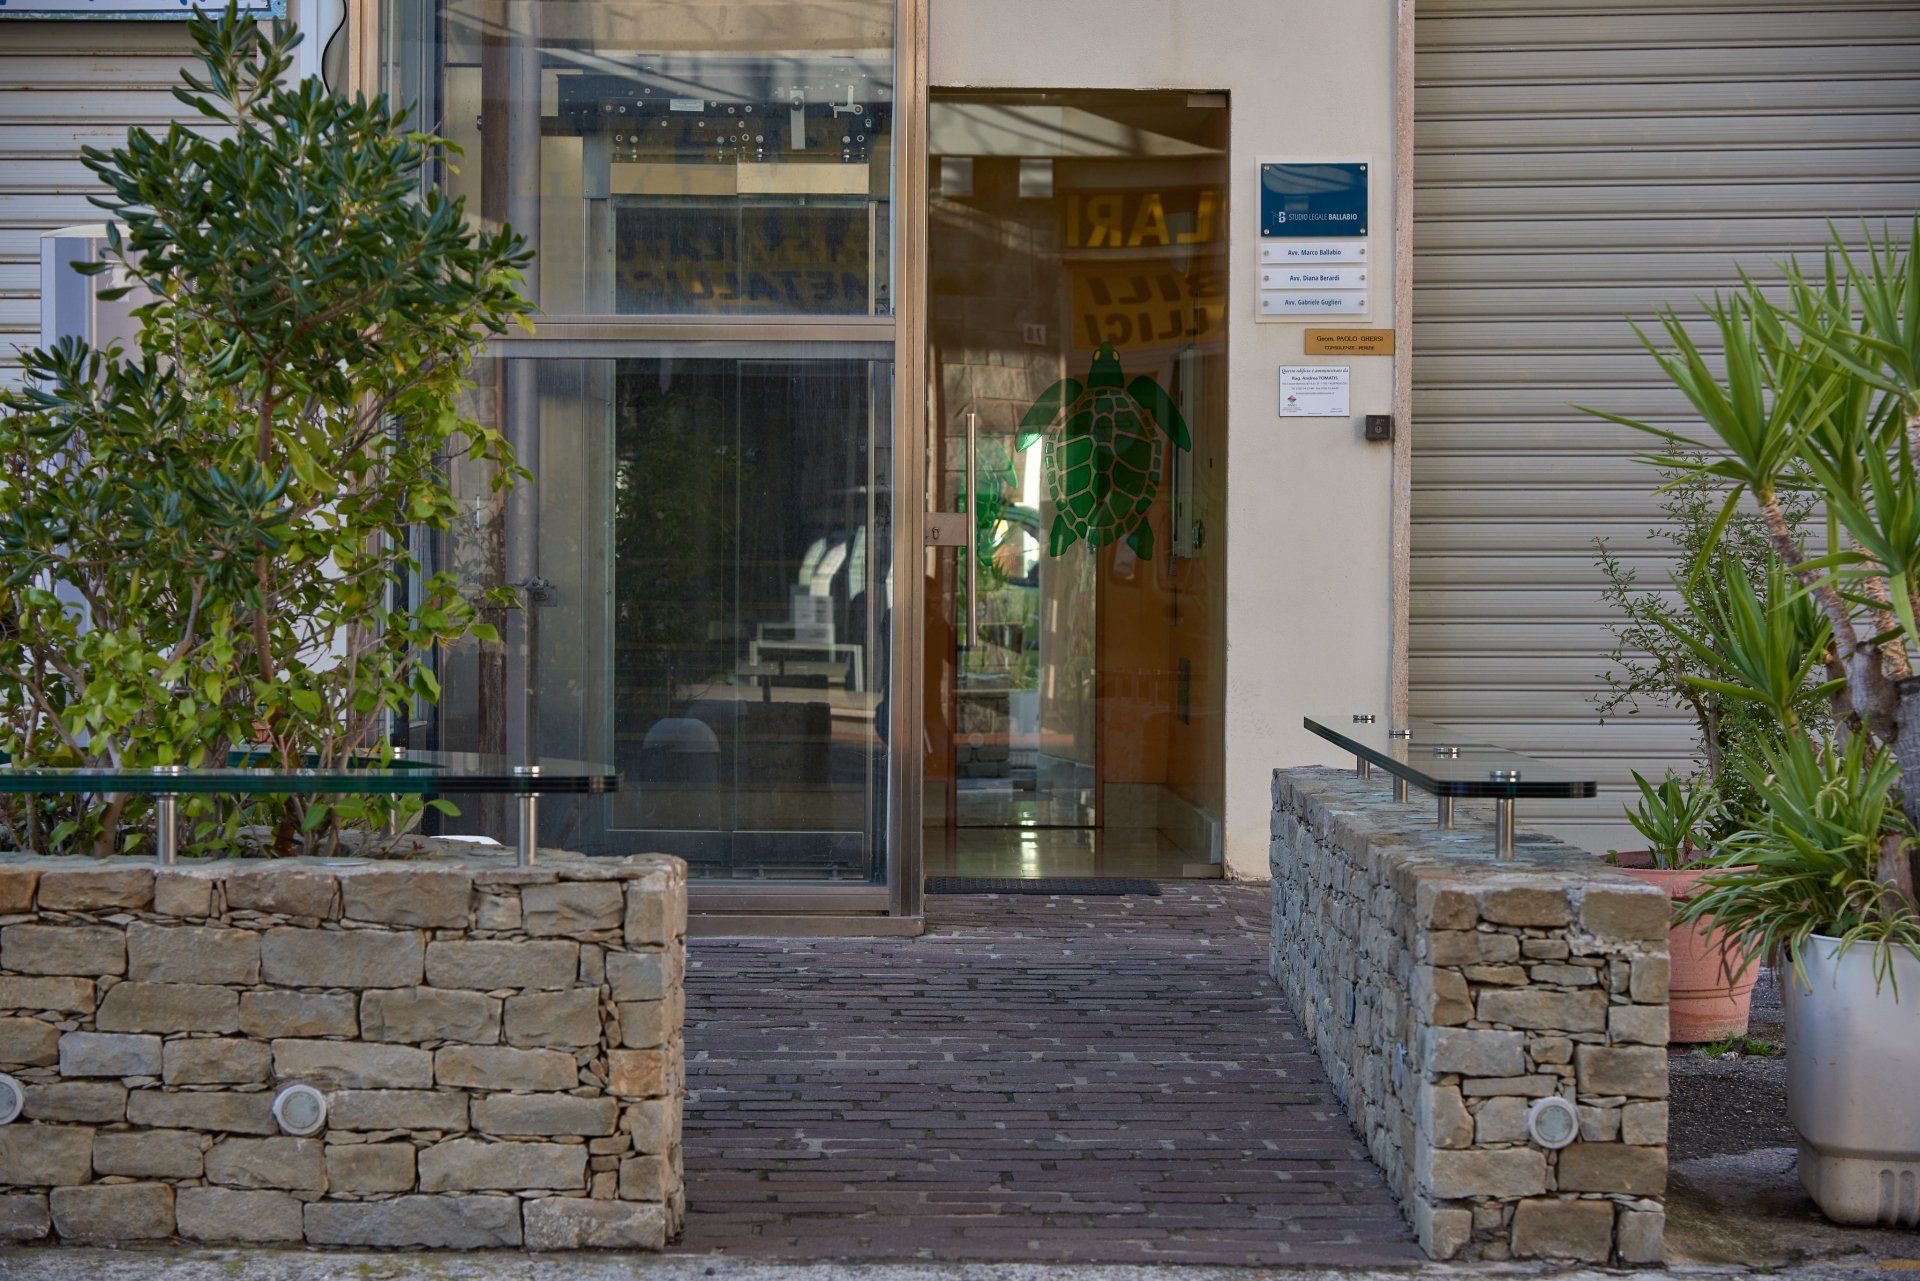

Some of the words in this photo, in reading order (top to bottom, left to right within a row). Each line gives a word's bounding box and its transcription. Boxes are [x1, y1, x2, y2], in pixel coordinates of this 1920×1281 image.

[1289, 213, 1308, 221] STUDIO
[1309, 213, 1327, 221] LEGALE
[1328, 213, 1358, 221] BALLABIO
